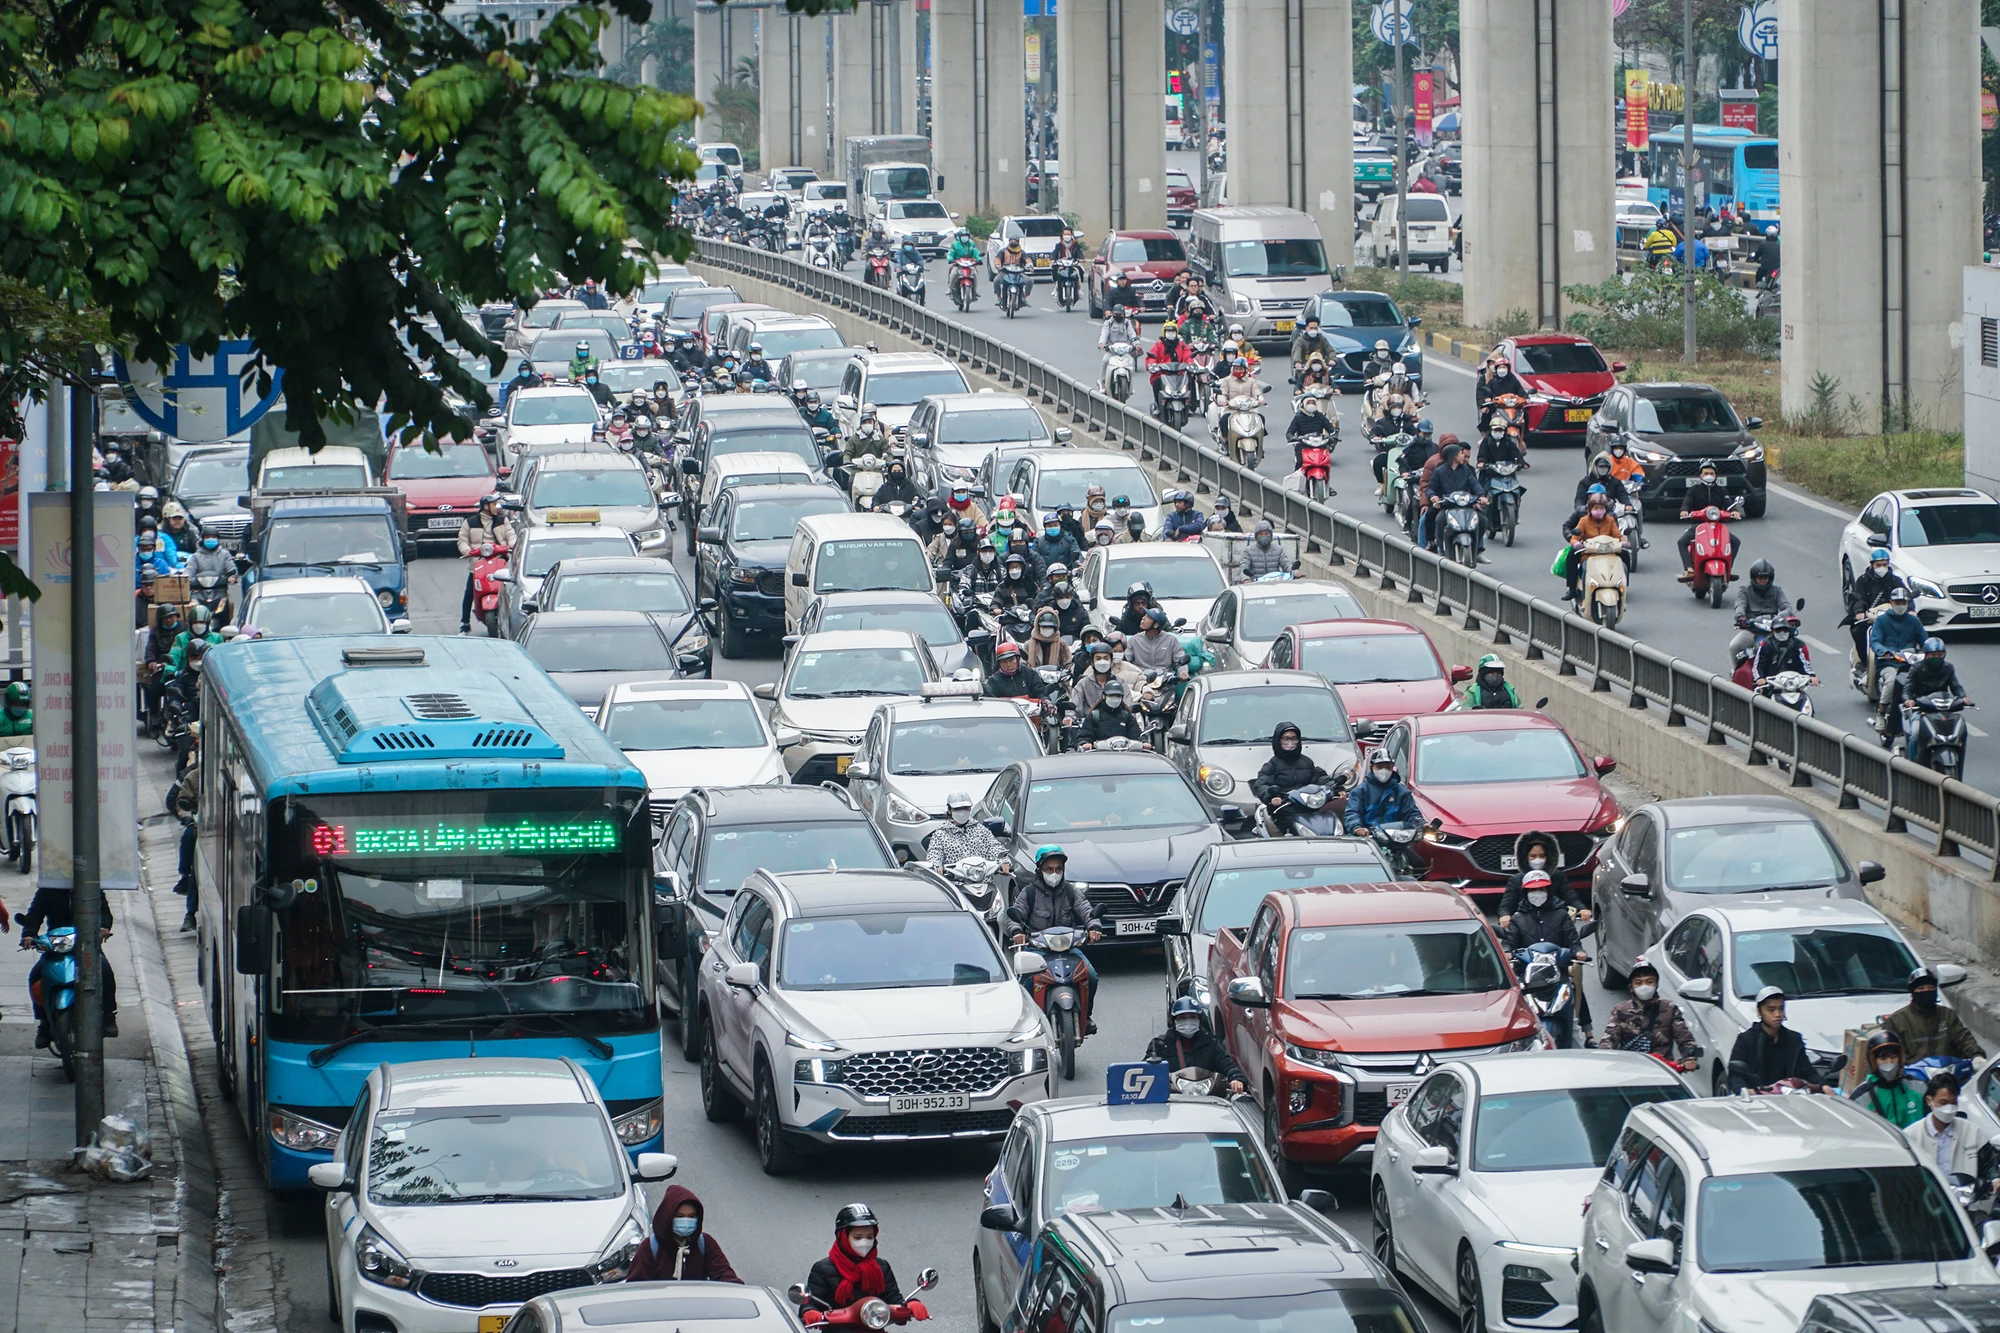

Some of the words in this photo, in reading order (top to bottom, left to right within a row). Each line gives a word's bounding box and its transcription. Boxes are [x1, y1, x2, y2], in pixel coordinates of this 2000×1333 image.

[313, 824, 350, 855] 01
[1122, 1067, 1155, 1100] G7
[896, 1096, 963, 1110] 30H-952.33
[1055, 1158, 1078, 1168] 2292
